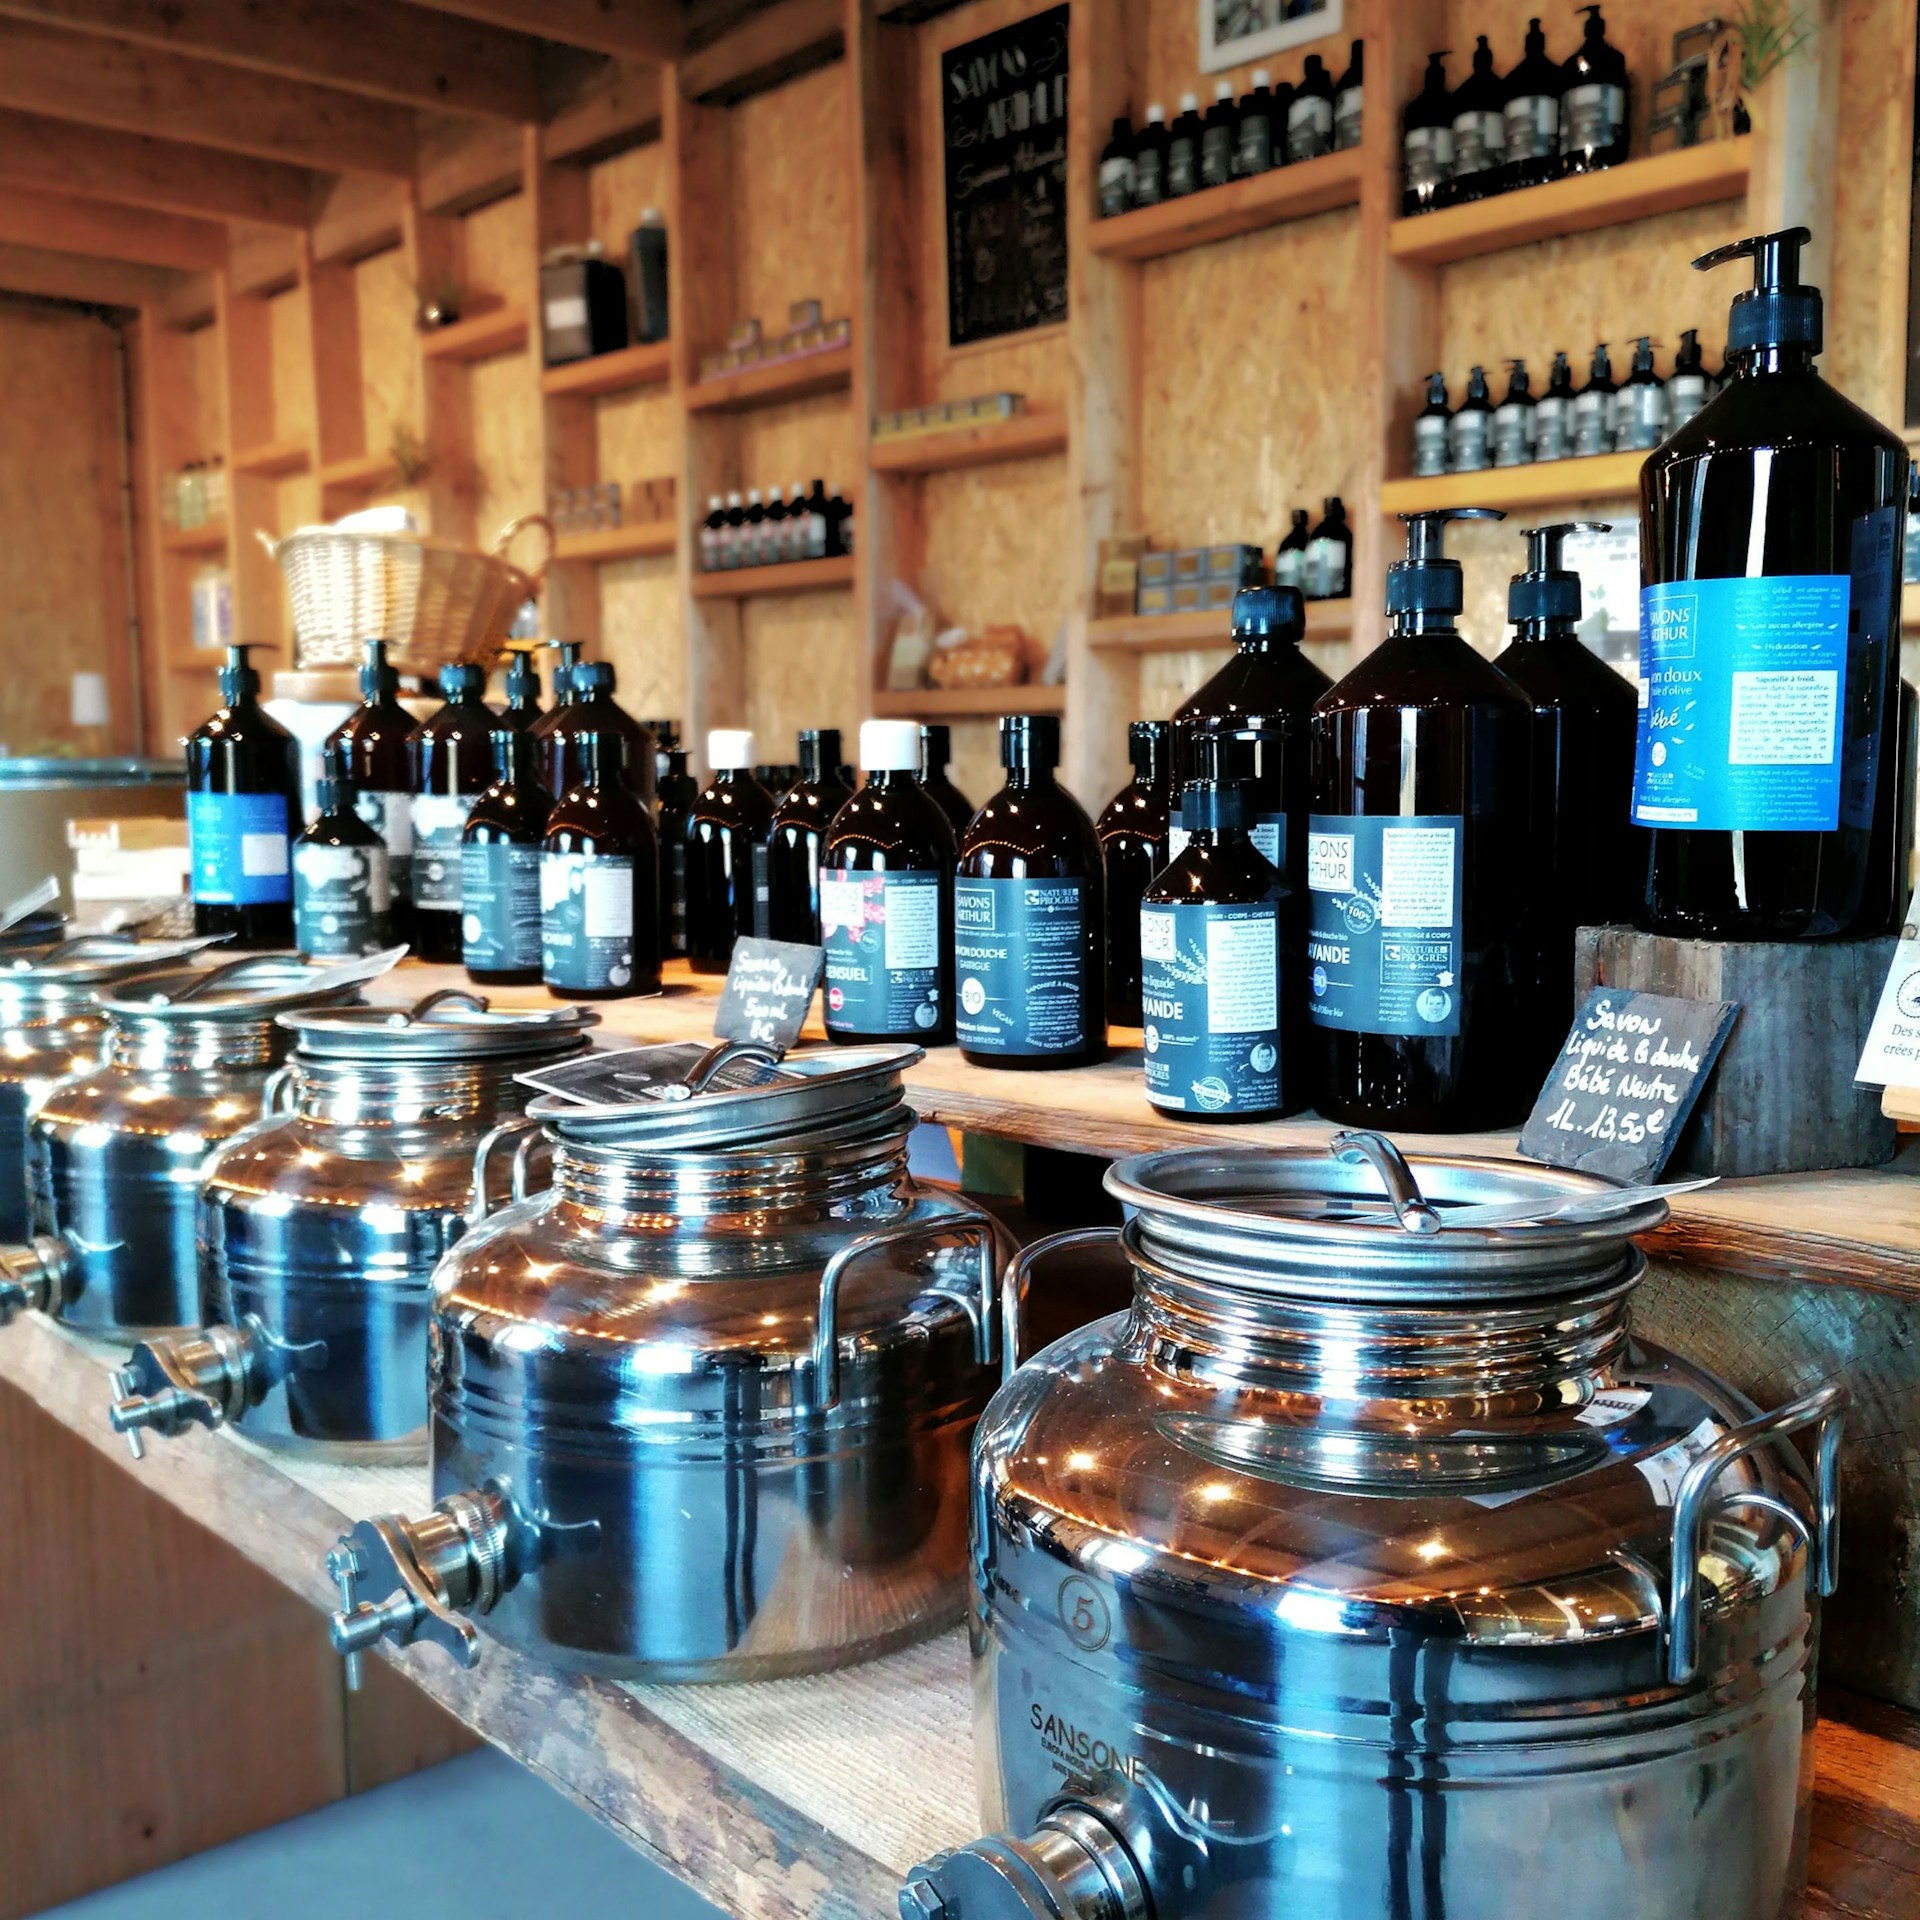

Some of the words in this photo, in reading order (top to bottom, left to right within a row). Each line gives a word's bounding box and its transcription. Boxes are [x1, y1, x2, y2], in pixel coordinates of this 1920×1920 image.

[1765, 643, 1808, 651] Hydratation
[1663, 665, 1703, 683] doux
[957, 895, 991, 909] SAVONS
[1348, 905, 1372, 924] 100%
[970, 946, 1008, 959] DOUCHE
[1401, 945, 1441, 954] NATURE
[1149, 975, 1175, 989] liquide
[991, 1007, 1016, 1028] VEGAN
[1586, 999, 1662, 1036] Savon
[1891, 1023, 1915, 1039] Des
[1883, 1042, 1915, 1057] crées
[1562, 1063, 1617, 1096] Bébé
[1615, 1073, 1681, 1105] Neutre
[1071, 1595, 1096, 1632] 5
[1029, 1702, 1147, 1789] SANSONE
